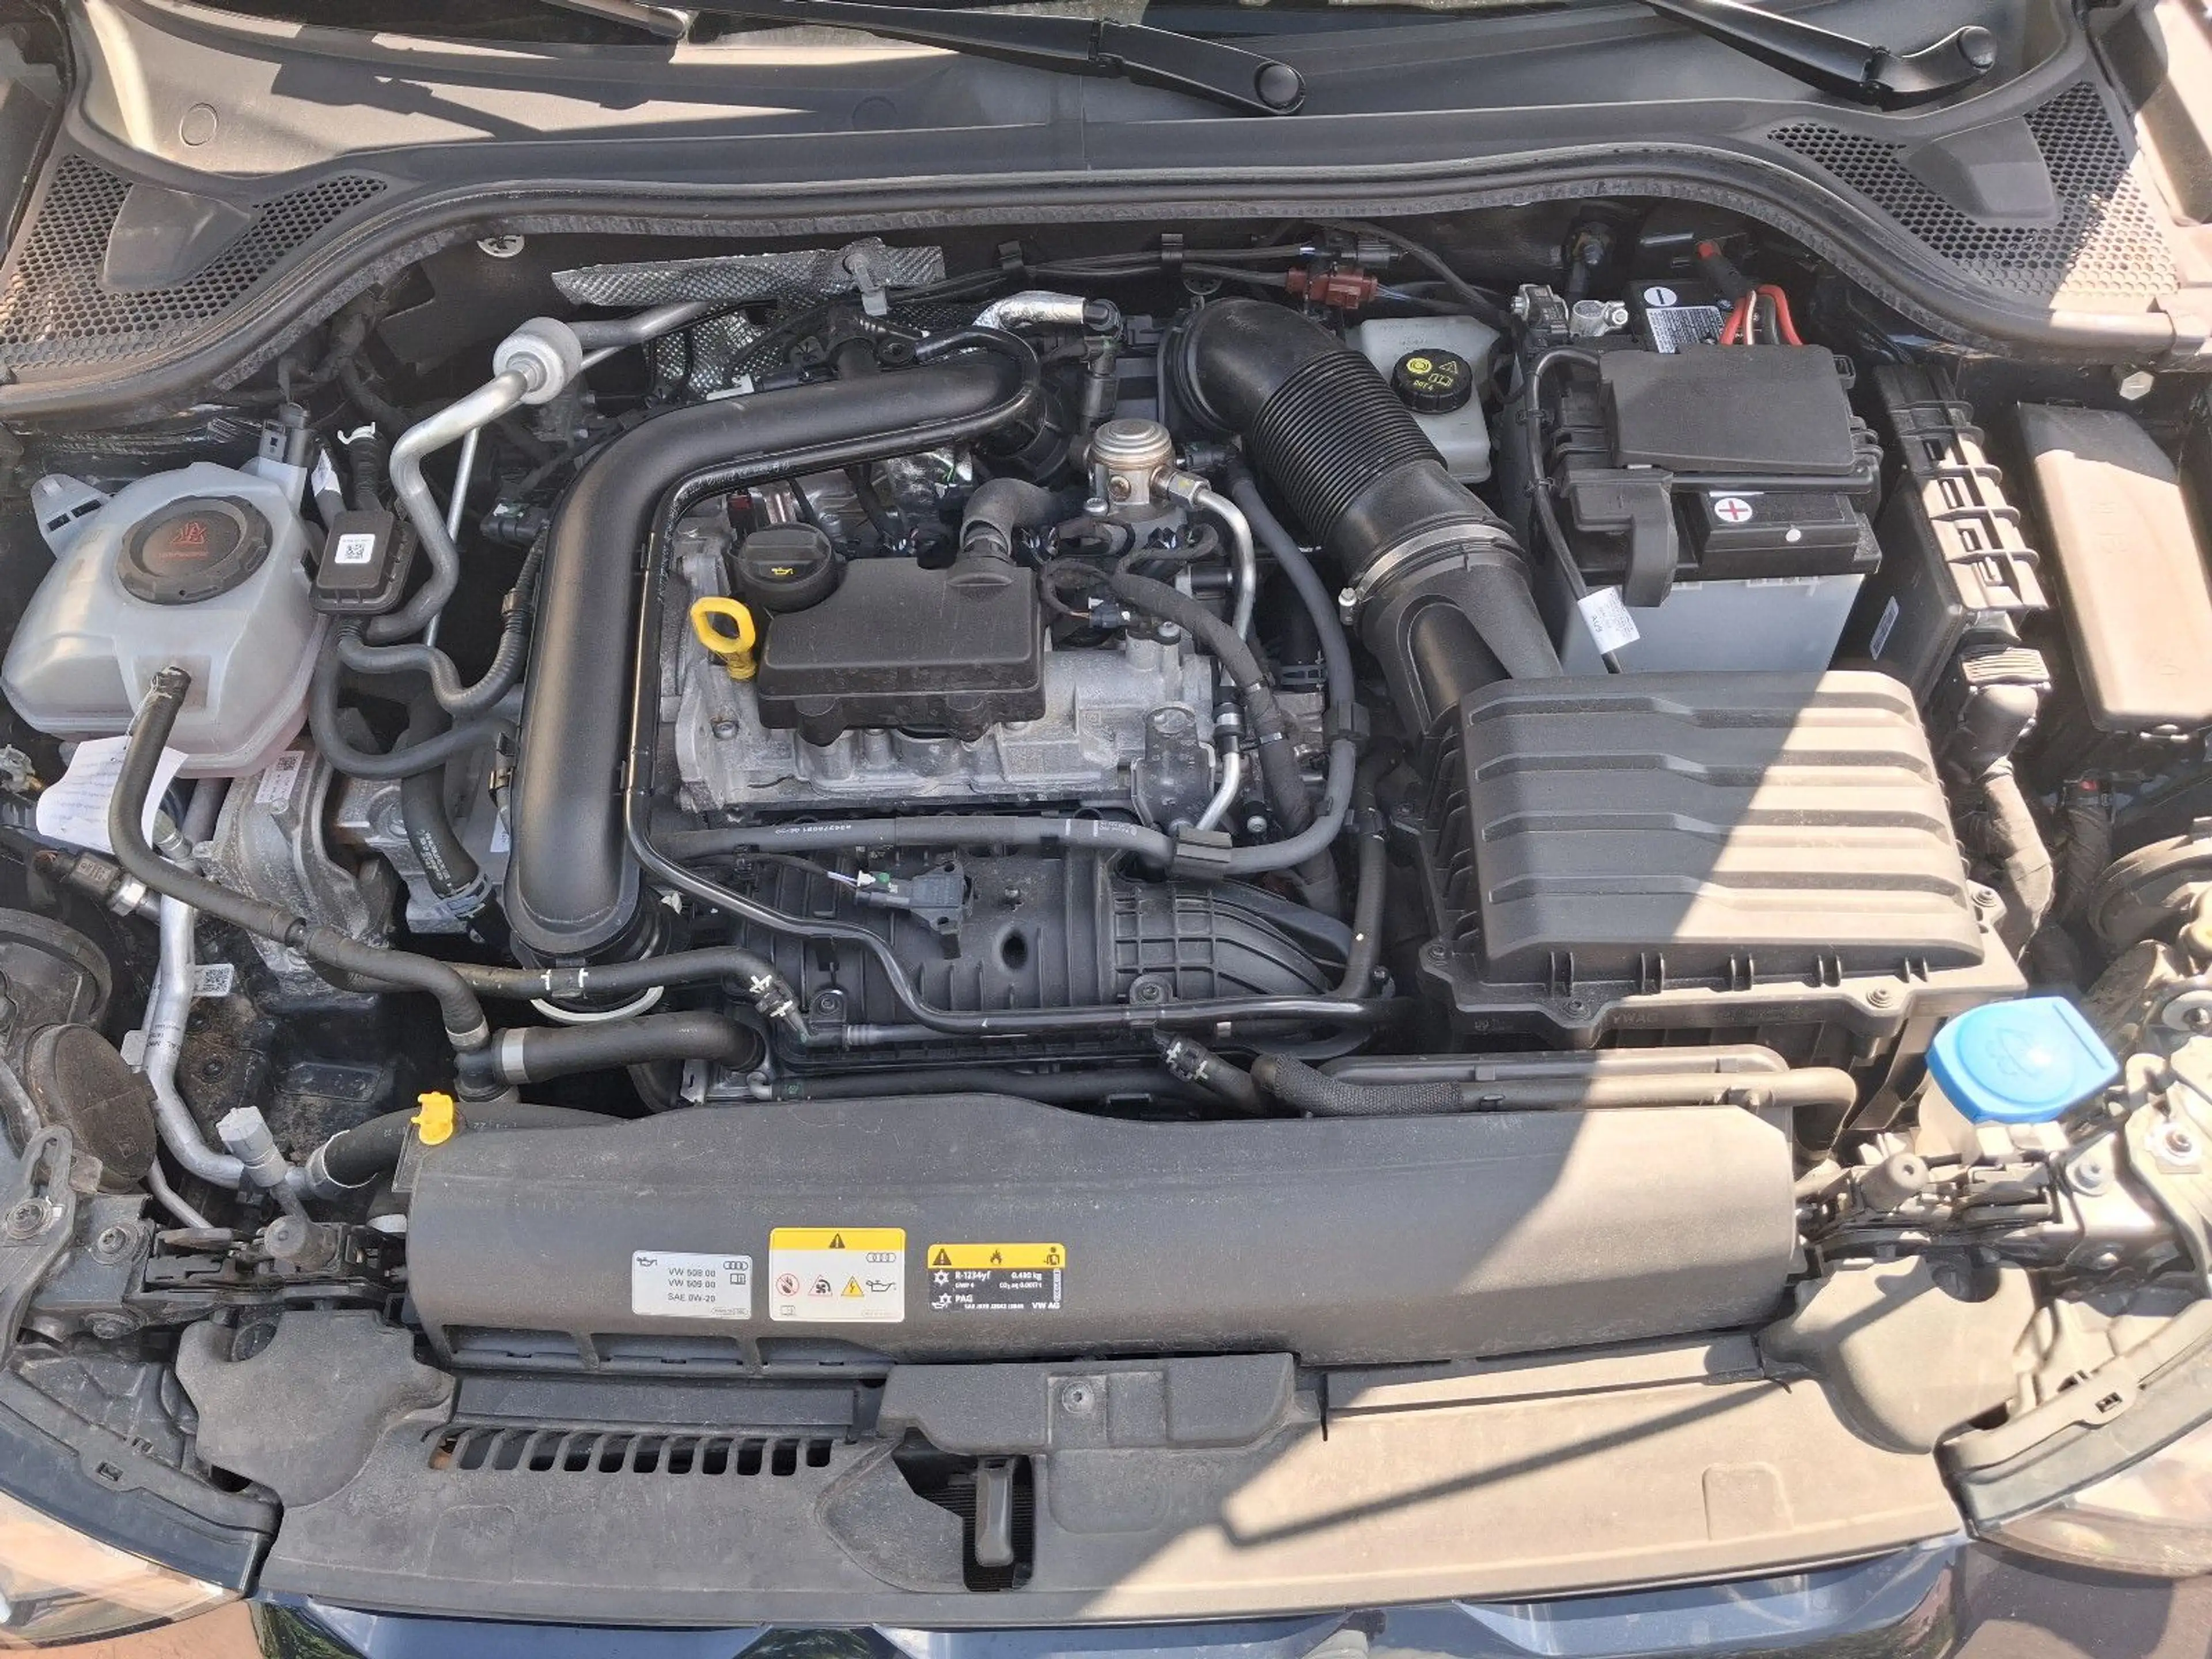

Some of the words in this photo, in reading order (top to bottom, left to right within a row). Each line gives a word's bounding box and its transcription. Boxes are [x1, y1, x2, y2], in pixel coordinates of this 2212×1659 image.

[1413, 380, 1429, 389] DOT
[668, 1267, 684, 1275] VW
[687, 1269, 703, 1277] 508
[955, 1271, 991, 1282] R-1234yf
[1033, 1271, 1042, 1281] kg
[668, 1279, 684, 1287] VW
[687, 1280, 703, 1288] 509
[705, 1281, 716, 1289] 00
[668, 1293, 685, 1301] SAE
[688, 1294, 715, 1302] 0W-20
[955, 1294, 973, 1302] PAG
